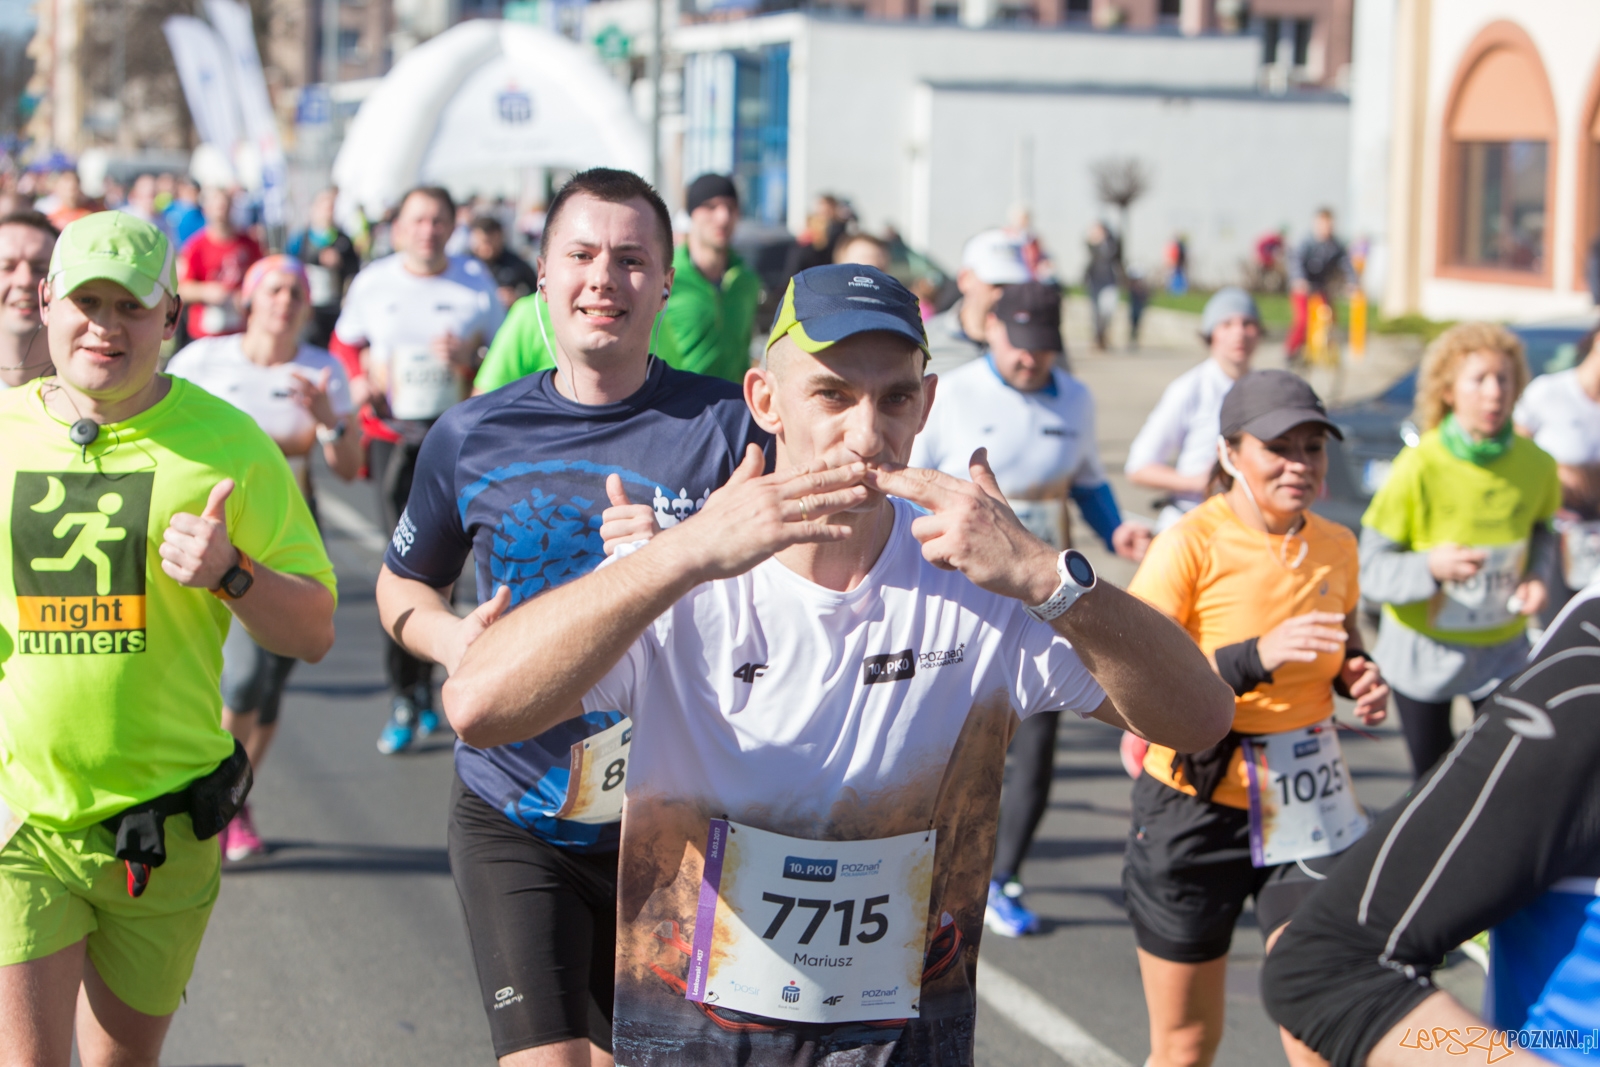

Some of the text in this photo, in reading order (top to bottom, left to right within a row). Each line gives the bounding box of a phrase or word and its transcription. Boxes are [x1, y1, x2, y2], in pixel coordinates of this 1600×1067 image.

[41, 597, 122, 629] night
[19, 630, 145, 653] runners
[733, 662, 769, 684] 4F
[868, 658, 909, 675] 10. PKO
[710, 827, 721, 858] 26.03.2017
[789, 863, 833, 876] 10. PKO
[762, 891, 890, 946] 7715
[793, 952, 853, 967] Mariusz
[822, 995, 844, 1006] 4F
